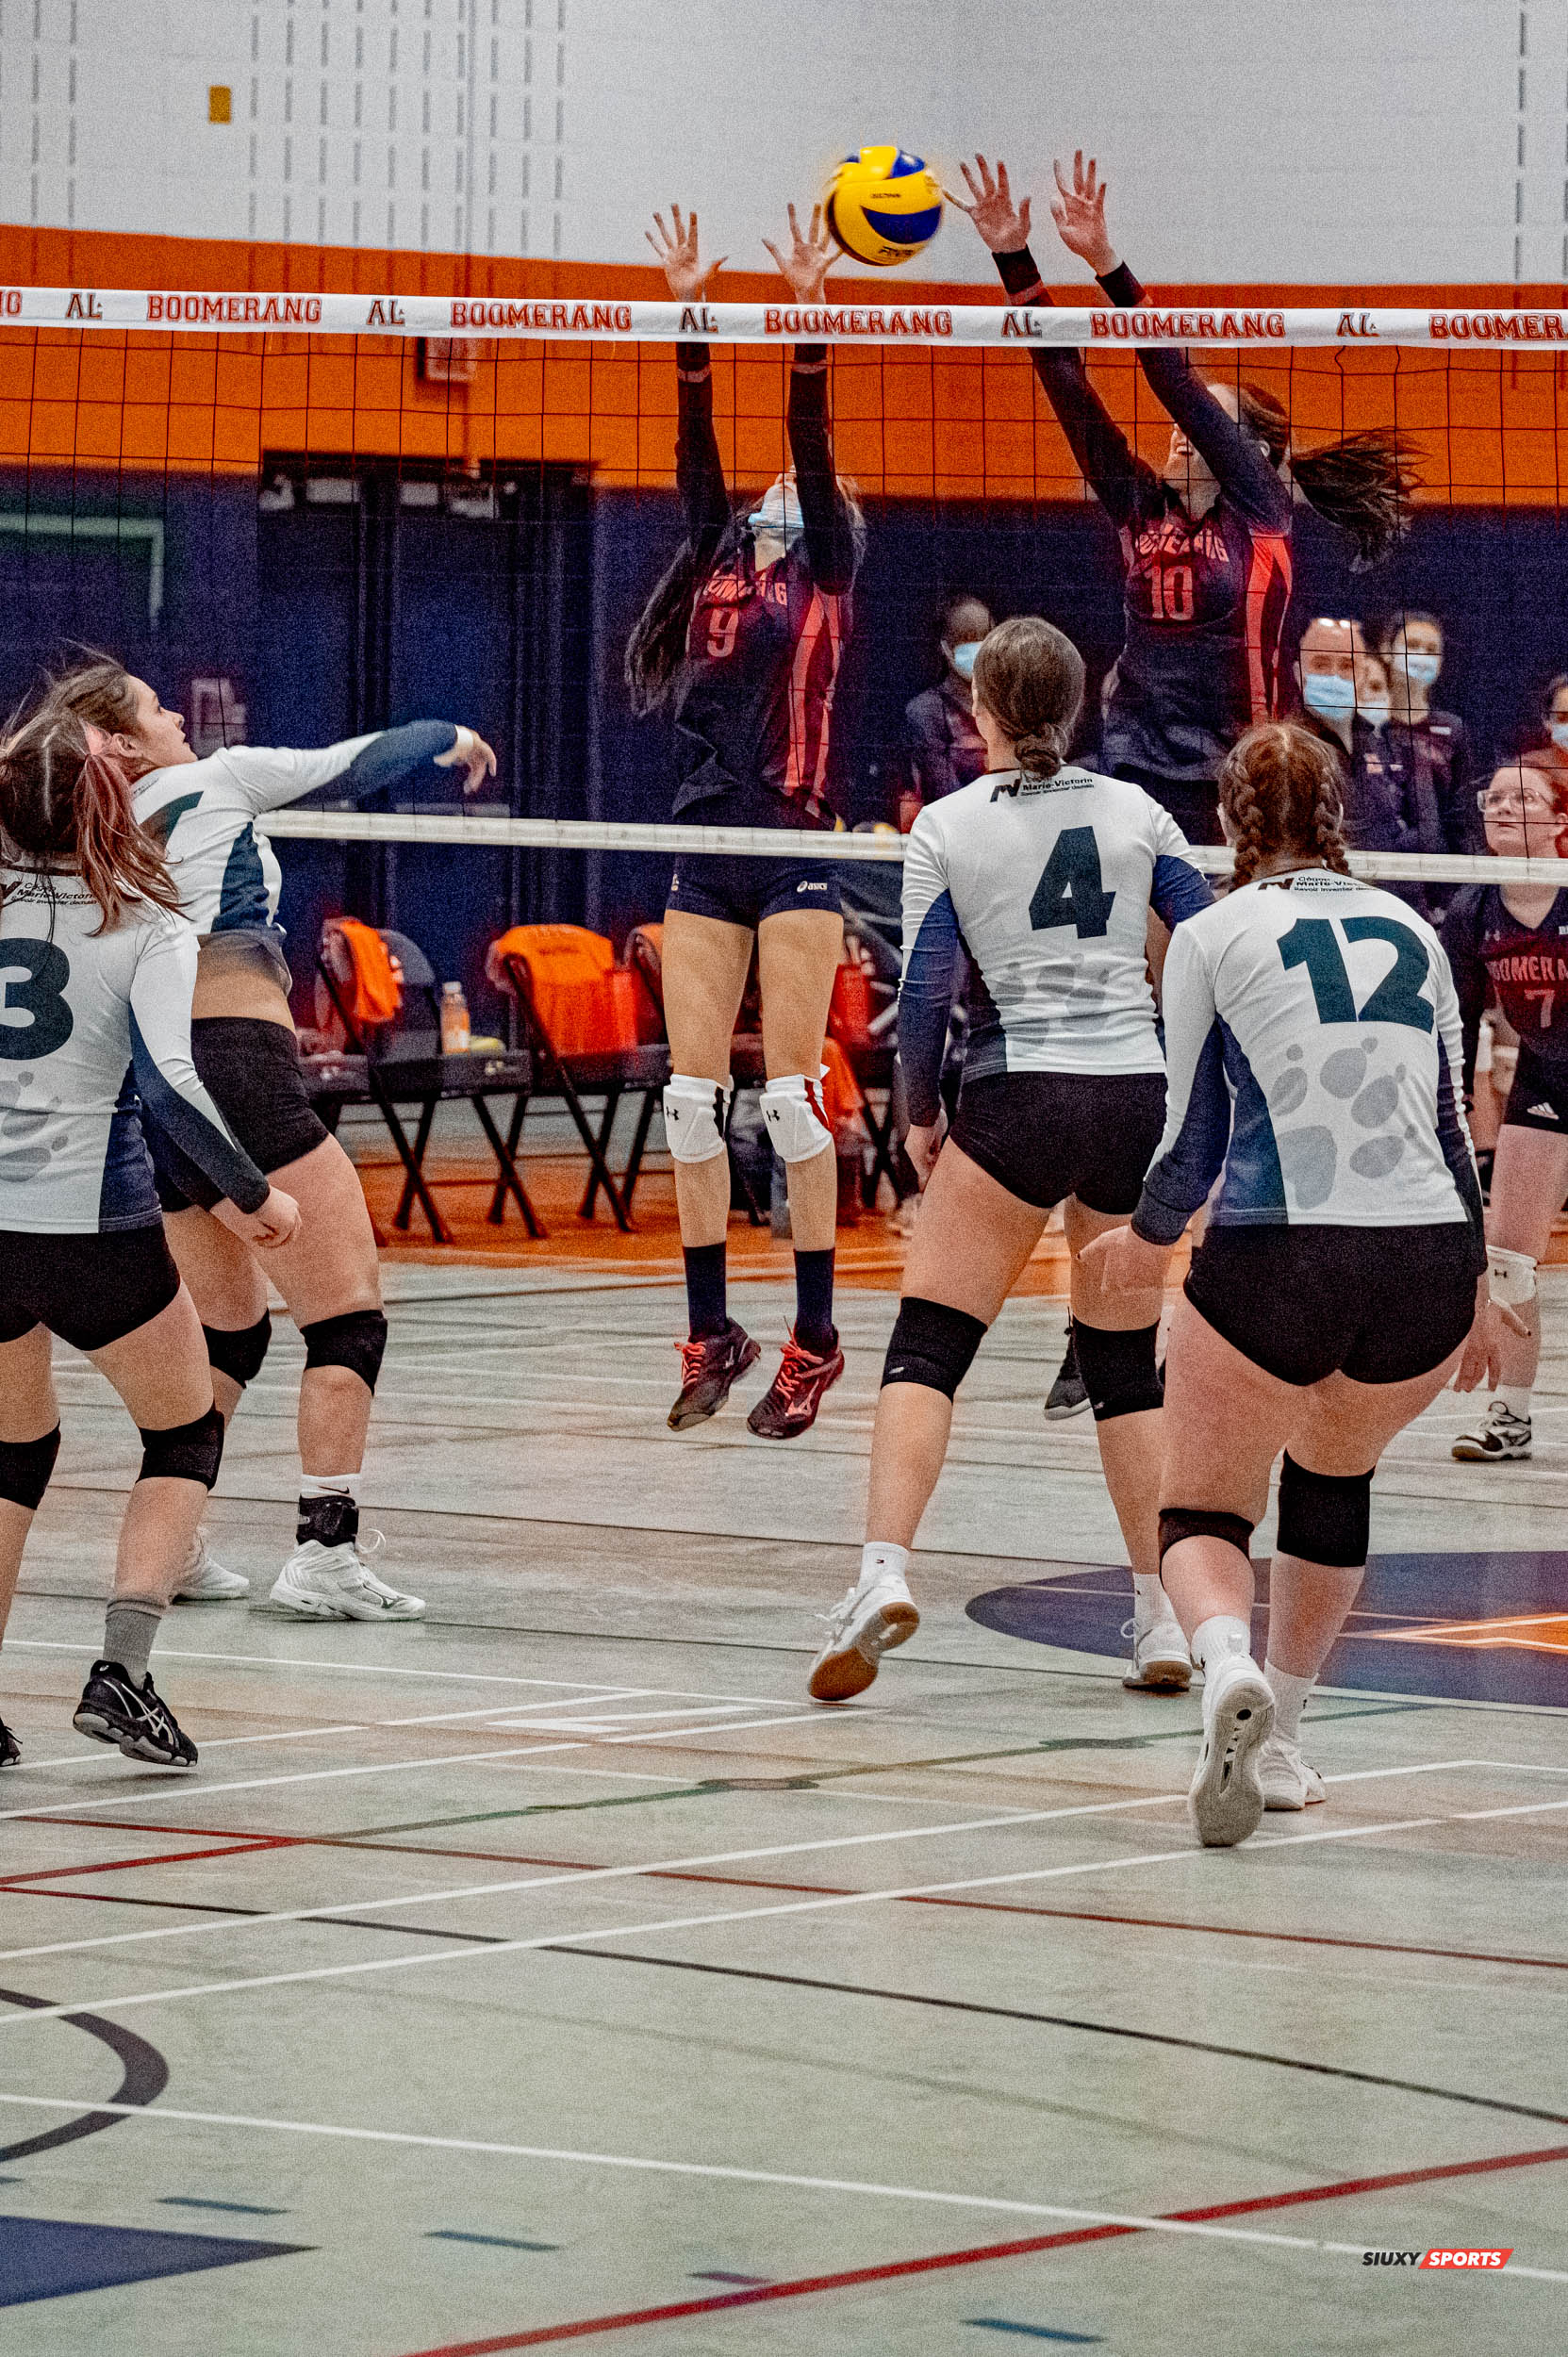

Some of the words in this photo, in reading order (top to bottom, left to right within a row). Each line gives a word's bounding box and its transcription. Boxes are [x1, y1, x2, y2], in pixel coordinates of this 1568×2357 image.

[0, 289, 23, 318] G
[146, 294, 322, 324] BOOMERANG
[450, 302, 632, 333] BOOMERANG
[764, 307, 952, 337] BOOMERANG
[1090, 309, 1286, 340] BOOMERANG
[1144, 565, 1195, 620] 10
[707, 606, 739, 657] 9
[1028, 826, 1116, 939] 4
[0, 937, 74, 1060] 3
[1277, 915, 1435, 1035] 12
[1524, 988, 1555, 1028] 7
